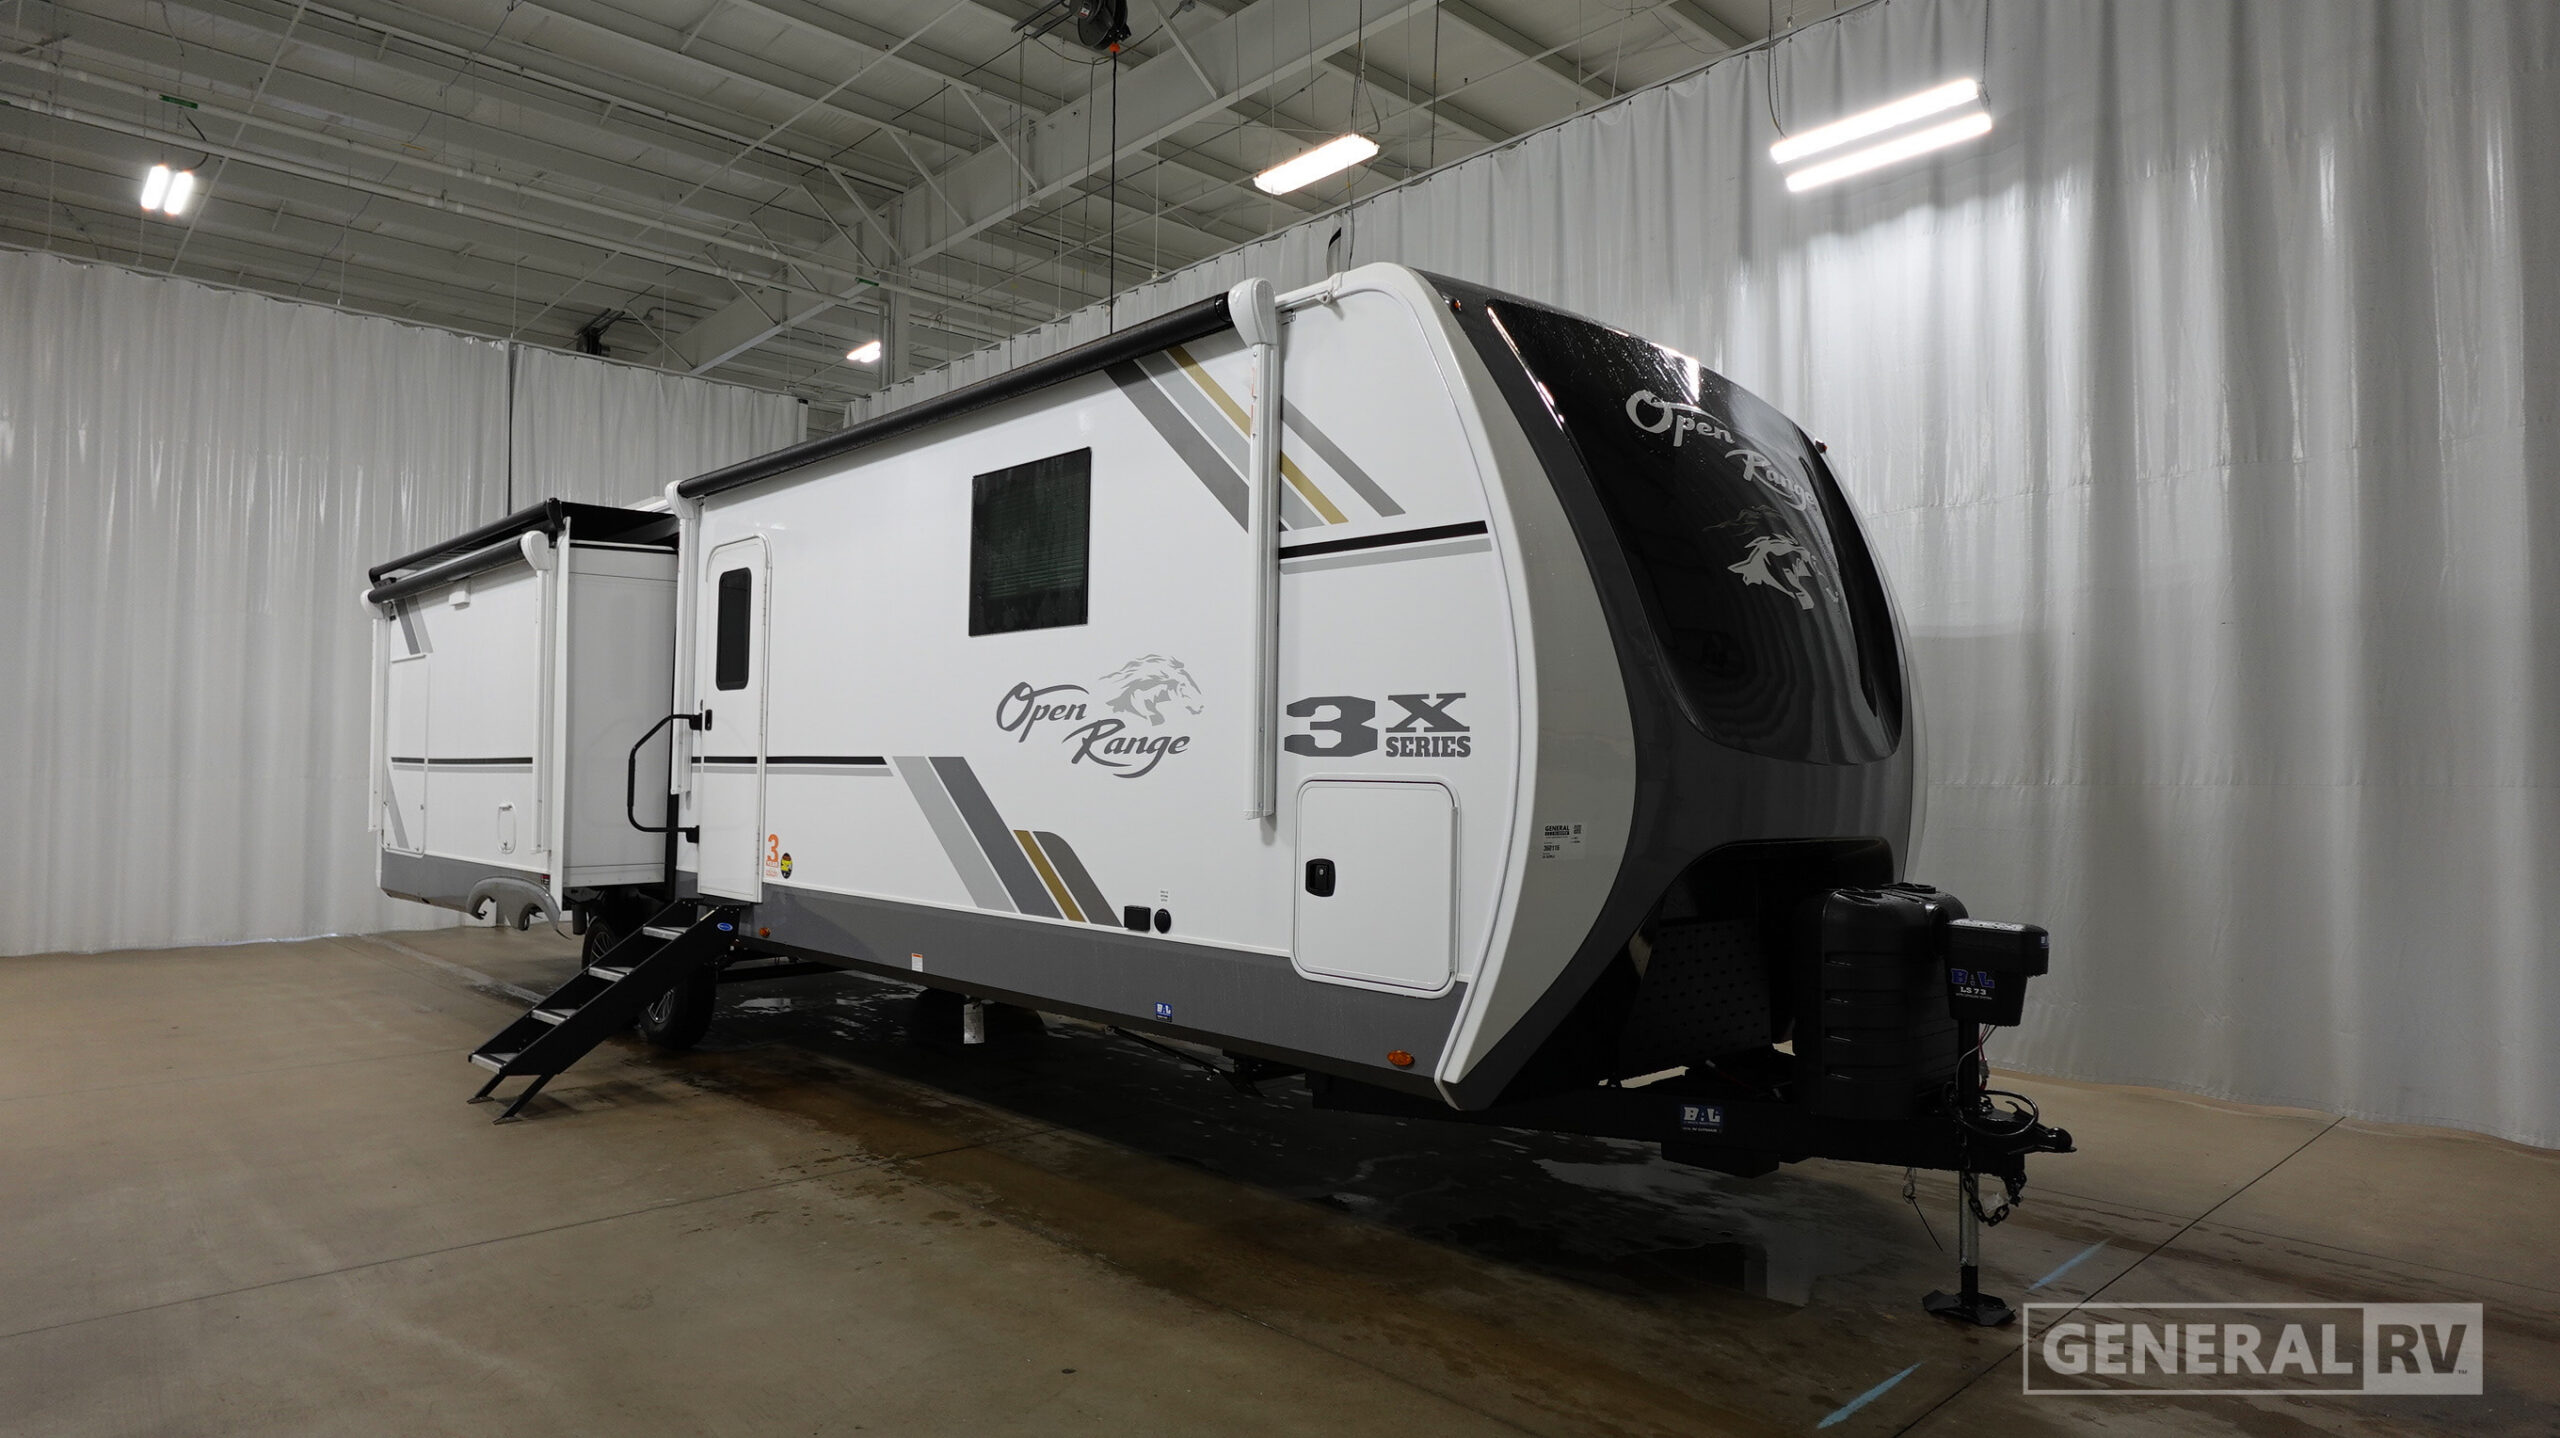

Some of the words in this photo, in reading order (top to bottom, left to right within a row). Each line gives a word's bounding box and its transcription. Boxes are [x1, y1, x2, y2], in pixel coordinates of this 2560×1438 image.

[1626, 389, 1736, 447] Open
[1725, 449, 1816, 512] Range
[996, 681, 1089, 743] Open
[1062, 718, 1191, 779] Range
[1385, 735, 1472, 758] SERIES
[767, 833, 779, 862] 3
